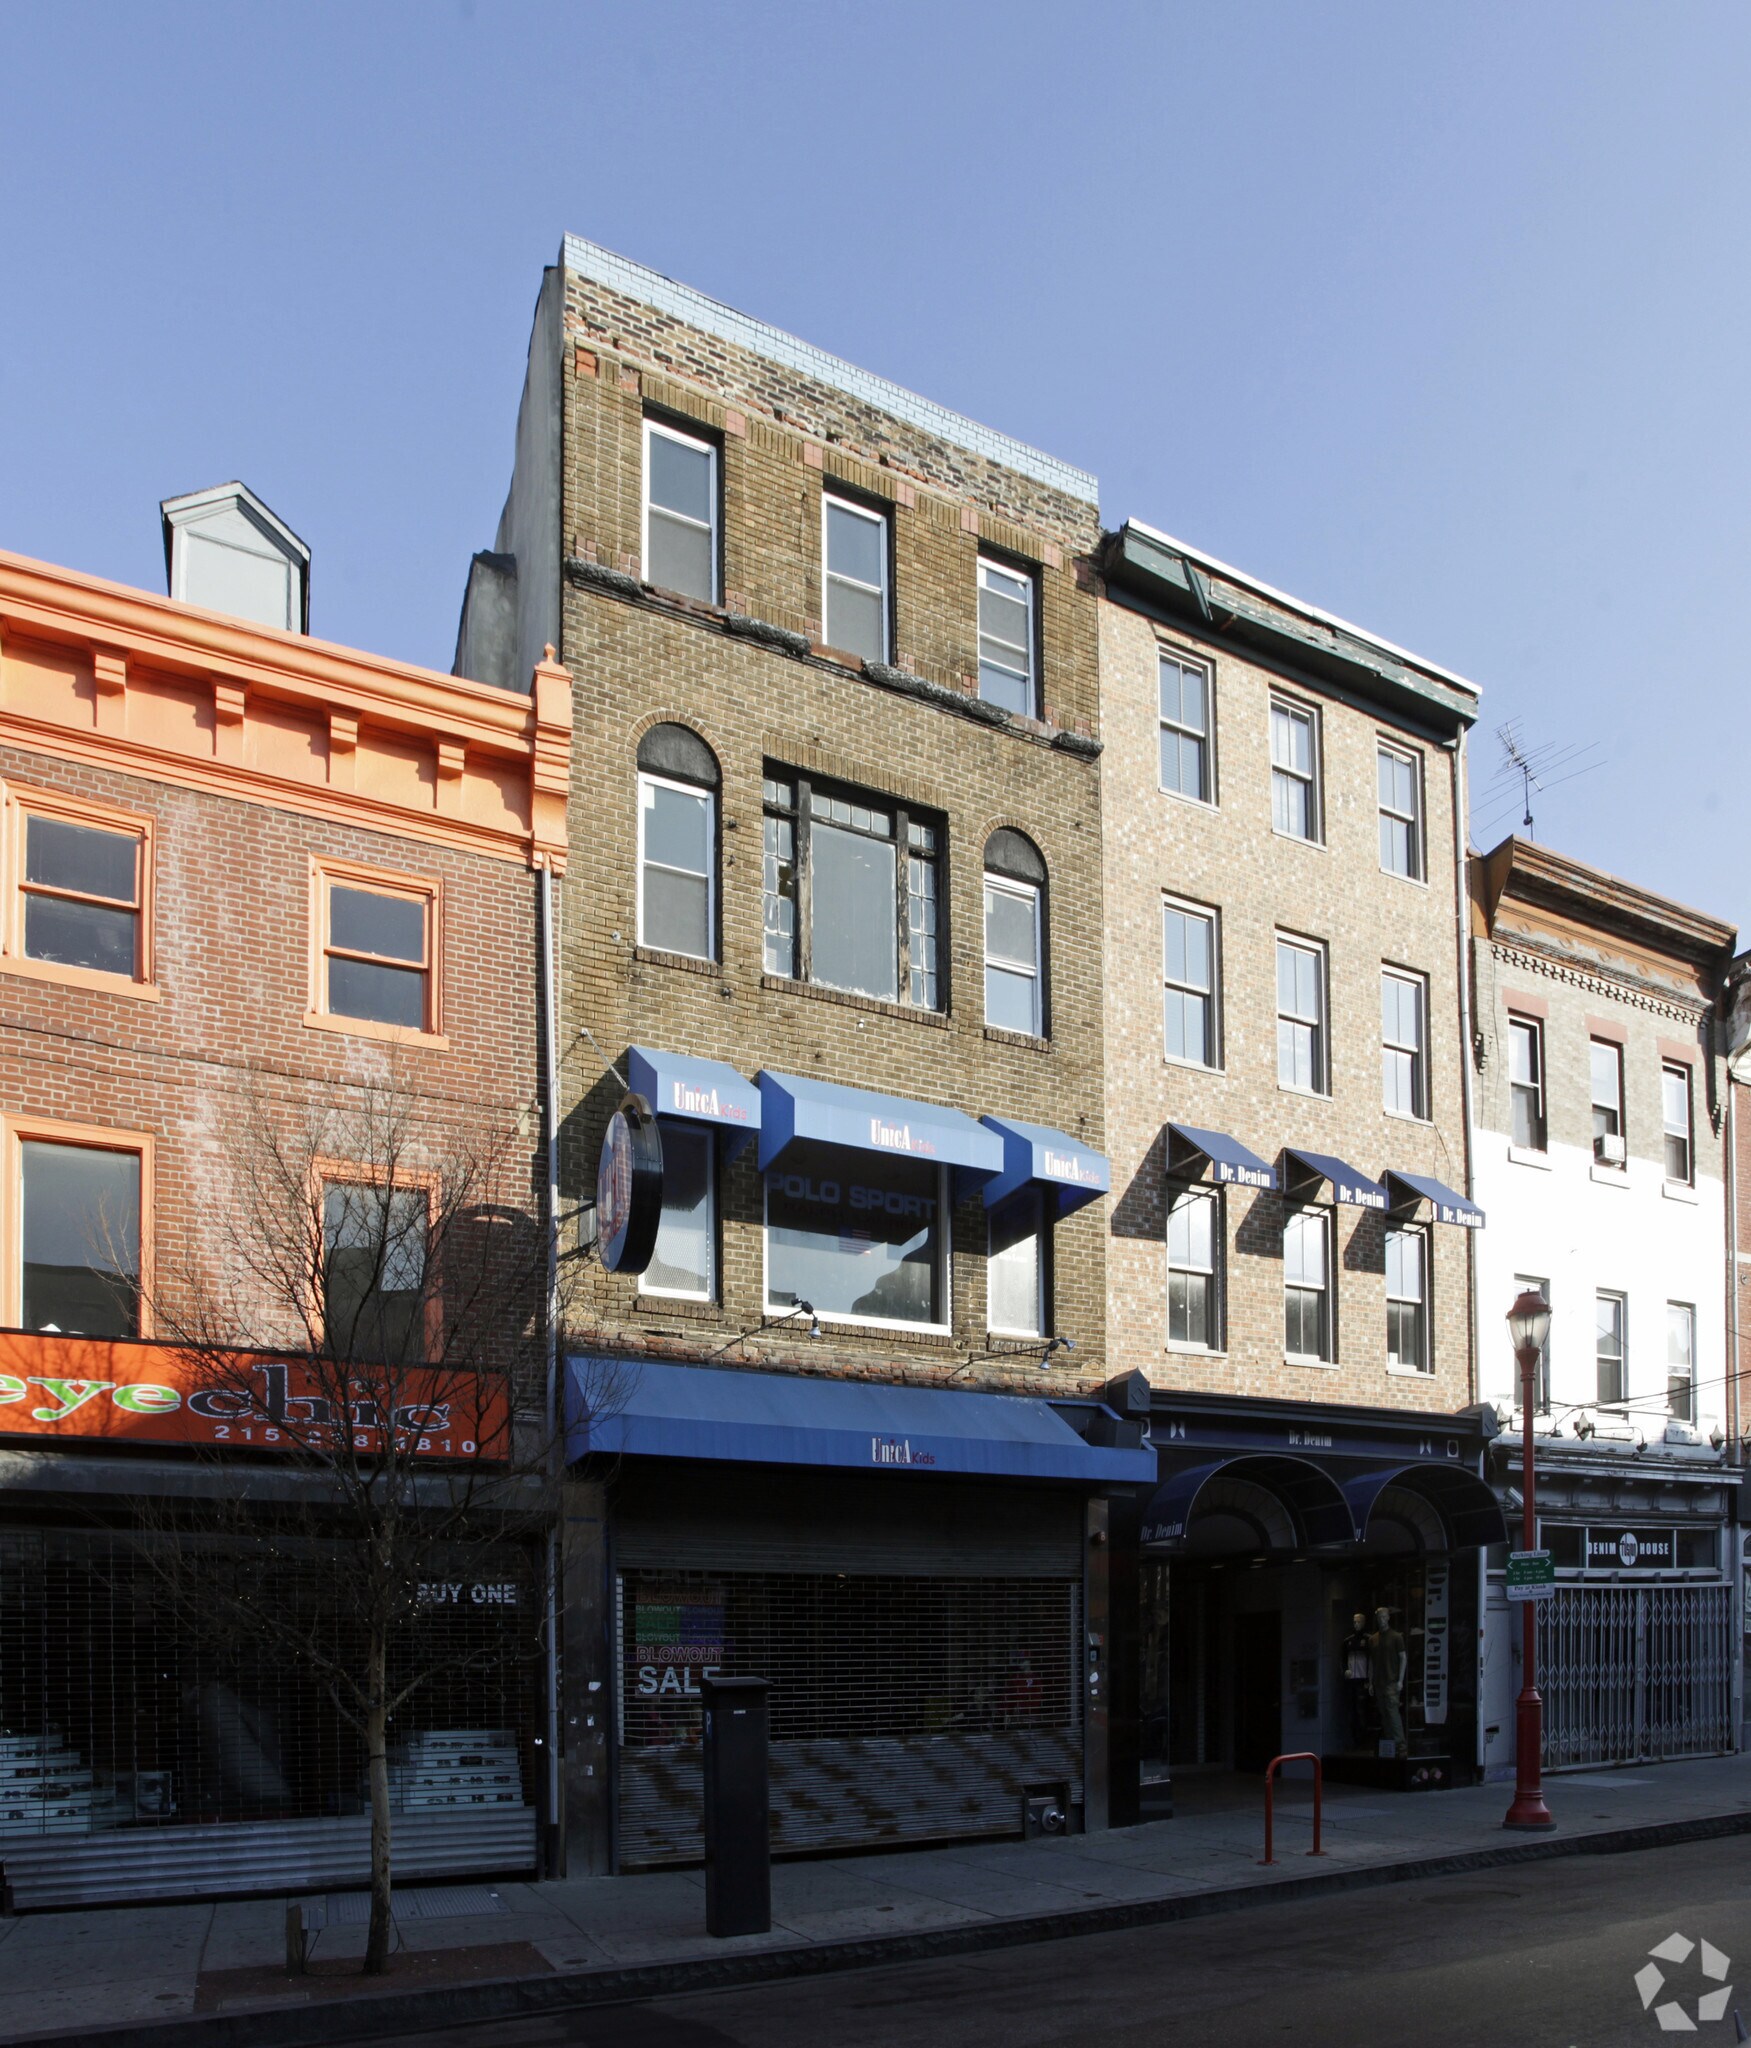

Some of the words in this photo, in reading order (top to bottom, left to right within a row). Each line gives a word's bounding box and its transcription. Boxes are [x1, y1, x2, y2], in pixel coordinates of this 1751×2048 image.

[720, 1104, 747, 1120] Kids
[911, 1138, 936, 1155] Kids
[1080, 1168, 1100, 1184] Kids
[1220, 1162, 1236, 1181] Dr.
[1237, 1166, 1271, 1187] Denim
[768, 1171, 840, 1205] POLO
[849, 1185, 936, 1220] SPORT
[1339, 1184, 1354, 1202] Dr.
[1355, 1188, 1385, 1208] Denim
[1442, 1206, 1455, 1222] Dr.
[1456, 1209, 1482, 1227] Denim
[1288, 1429, 1302, 1446] Dr.
[1303, 1431, 1332, 1447] Denim
[872, 1437, 911, 1464] UnicA
[911, 1451, 936, 1465] Kids
[1155, 1521, 1182, 1539] Denim
[1588, 1542, 1617, 1555] DENIM
[1639, 1542, 1669, 1555] HOUSE
[471, 1583, 516, 1604] ONE
[1427, 1566, 1447, 1605] Dr.
[636, 1646, 724, 1662] BLOWOUT
[1426, 1617, 1447, 1707] Denim
